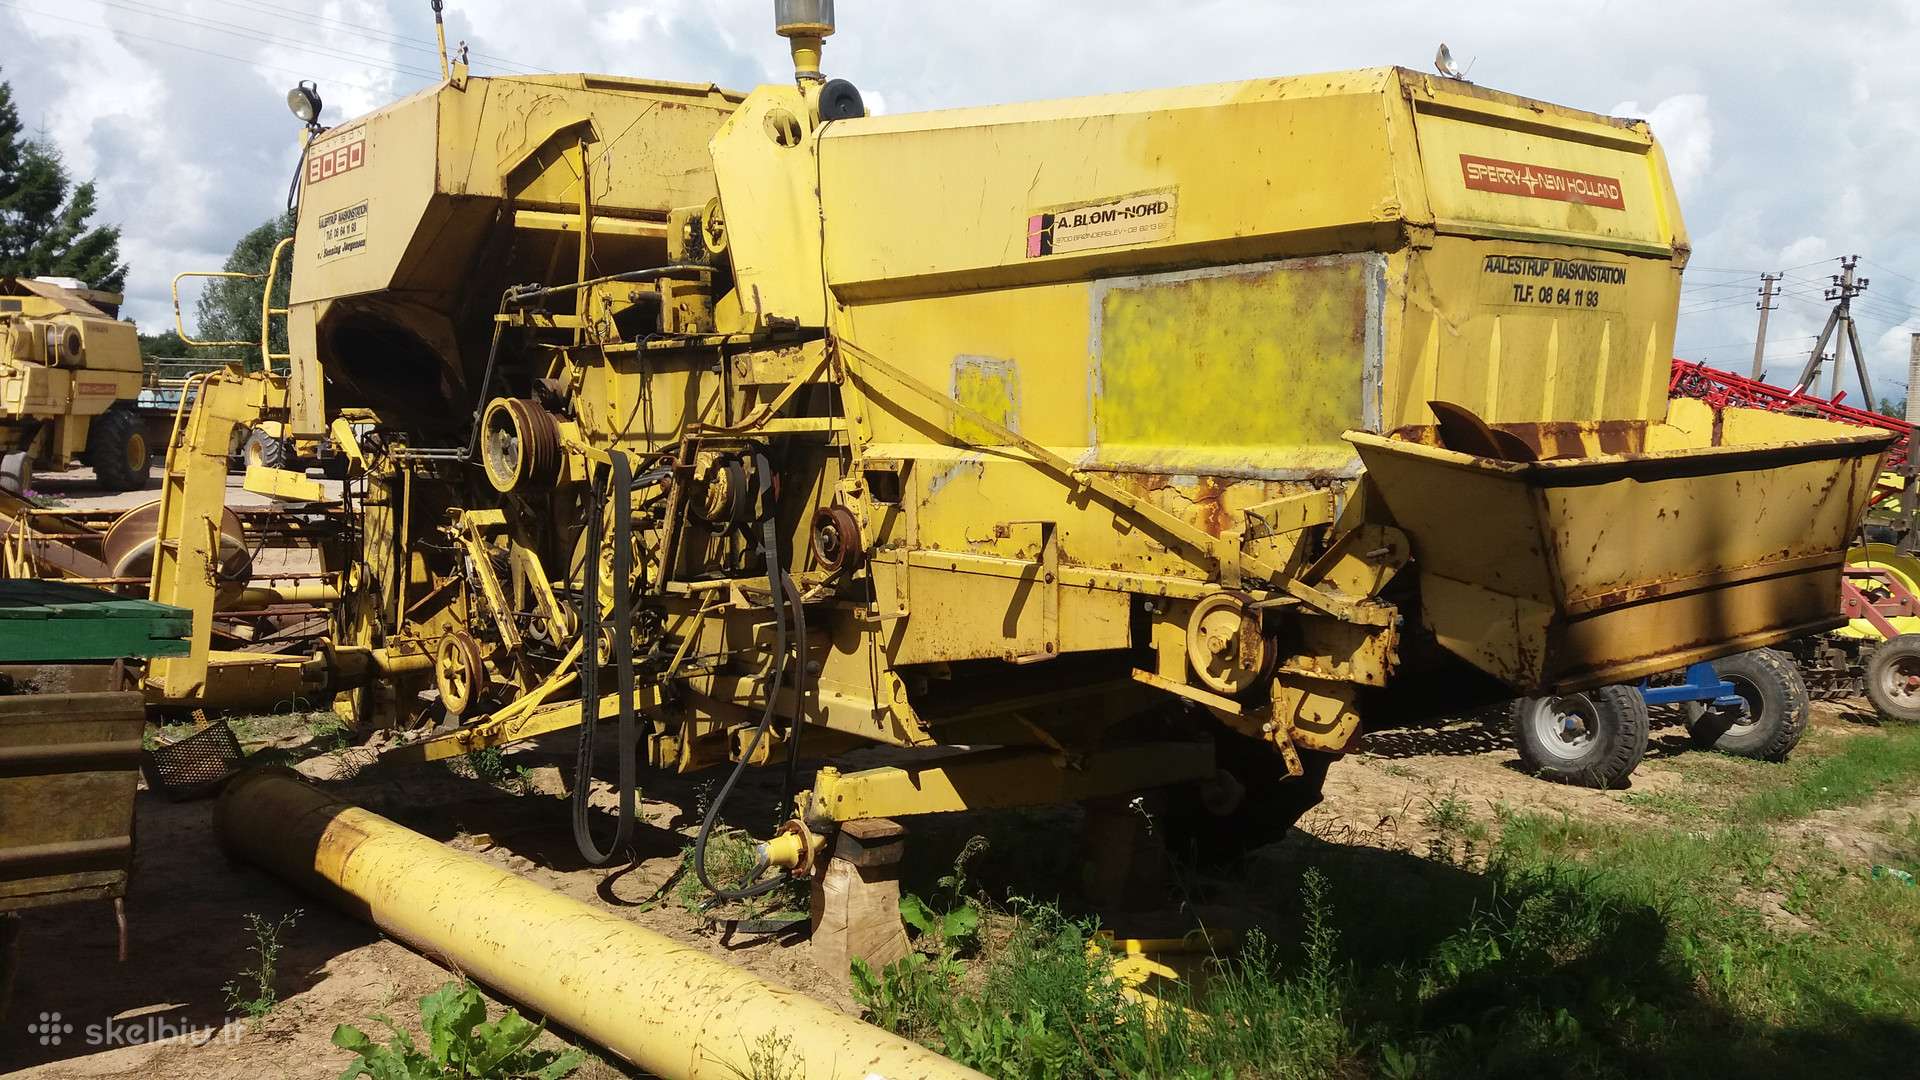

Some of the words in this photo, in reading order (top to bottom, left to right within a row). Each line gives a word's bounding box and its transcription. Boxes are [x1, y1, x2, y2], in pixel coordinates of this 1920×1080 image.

[310, 141, 362, 183] 8060
[1466, 162, 1521, 185] SPERRY
[1537, 173, 1566, 192] NEW
[1567, 178, 1619, 200] HOLLAND
[1484, 257, 1549, 278] AALESTRUP
[1552, 261, 1627, 285] MASKINSTATION
[1513, 284, 1534, 303] TLF.
[1538, 286, 1553, 303] 08
[1557, 288, 1570, 305] 64
[1574, 289, 1582, 306] 11
[1586, 290, 1599, 307] 93
